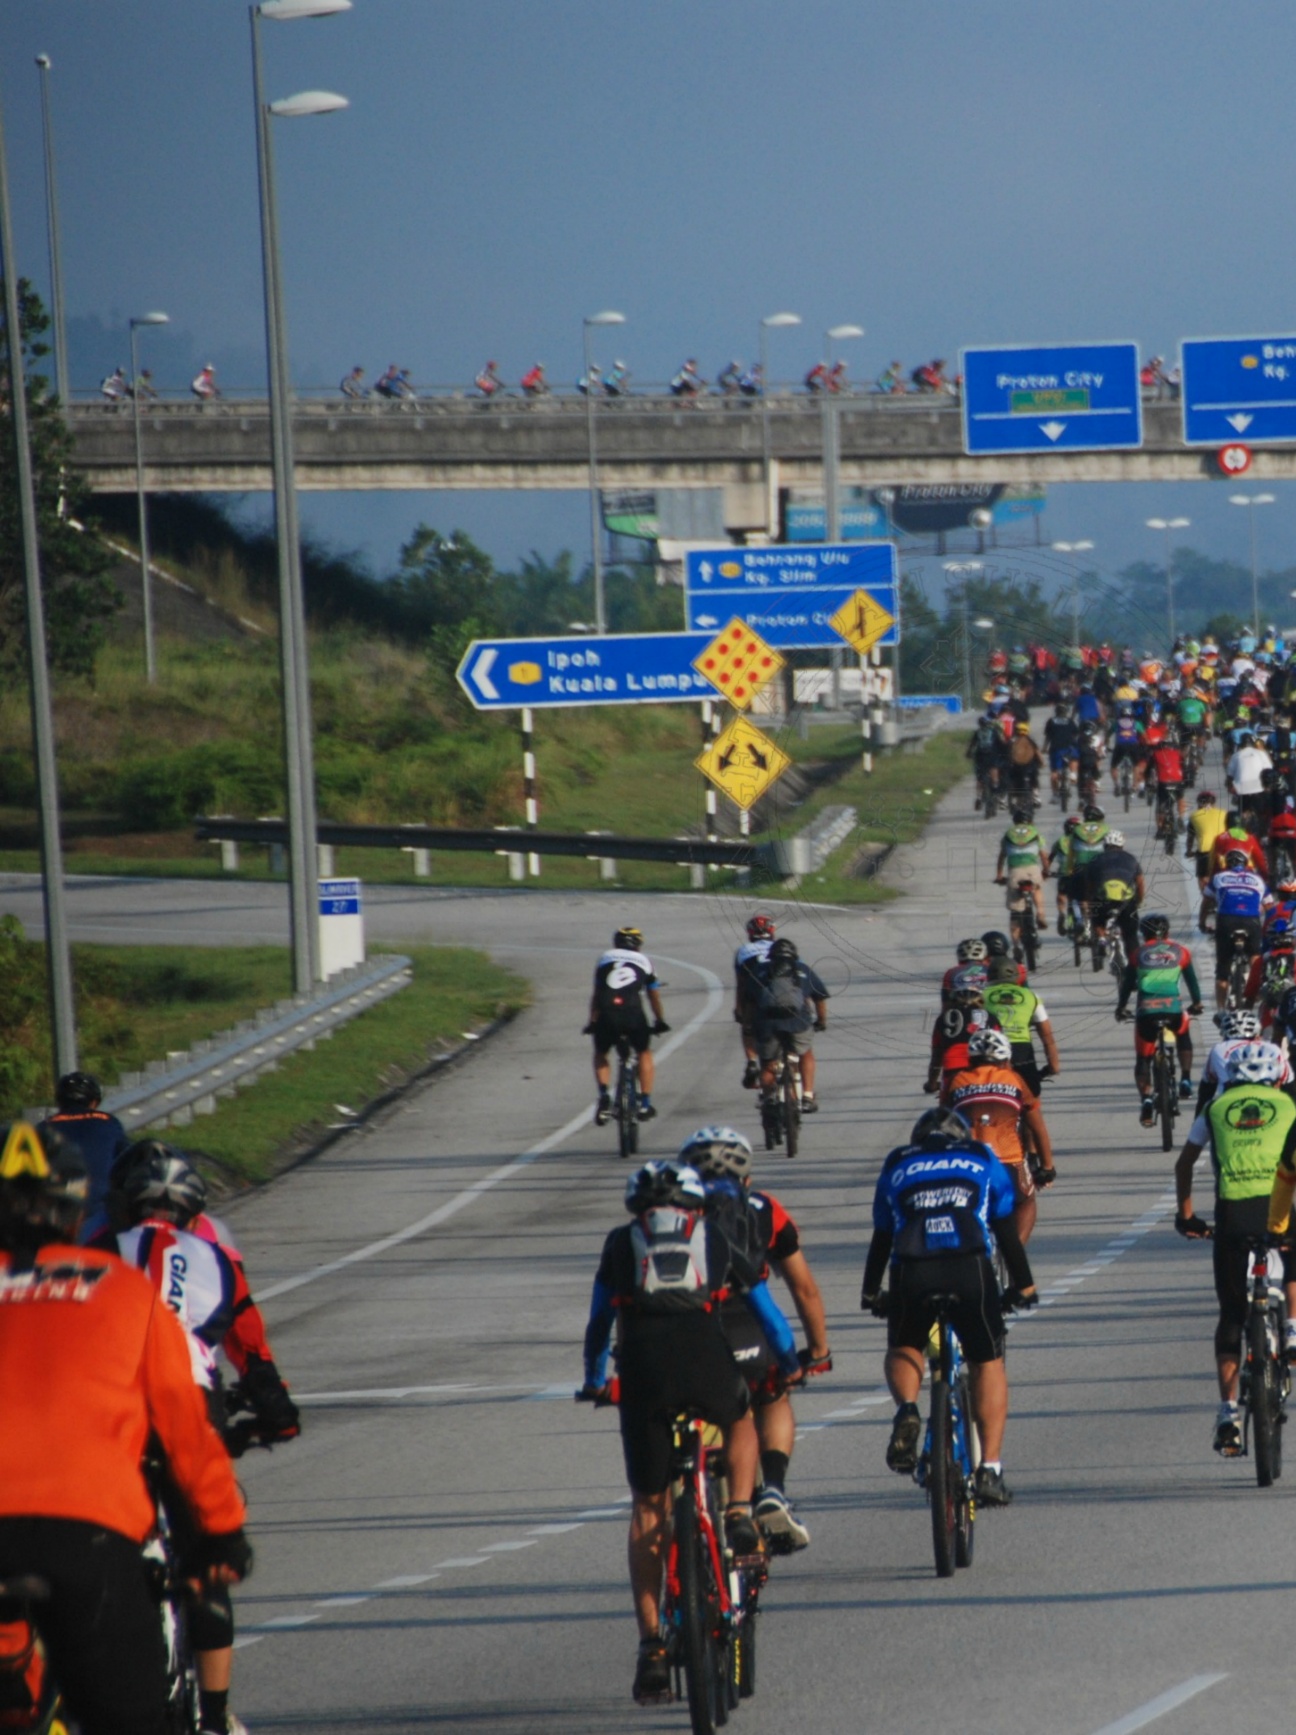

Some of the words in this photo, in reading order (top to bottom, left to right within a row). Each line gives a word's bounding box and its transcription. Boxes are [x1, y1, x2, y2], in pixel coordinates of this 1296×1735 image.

[996, 373, 1059, 389] Proton
[1064, 370, 1104, 389] City
[1263, 364, 1290, 381] Kg.
[743, 553, 817, 567] Behrang
[820, 551, 850, 565] Ulu
[779, 569, 817, 583] Slim
[746, 612, 808, 627] Proton
[548, 648, 600, 671] Ipoh
[549, 673, 618, 693] Kuala
[626, 672, 708, 692] Lumpu
[906, 1158, 985, 1176] GIANT
